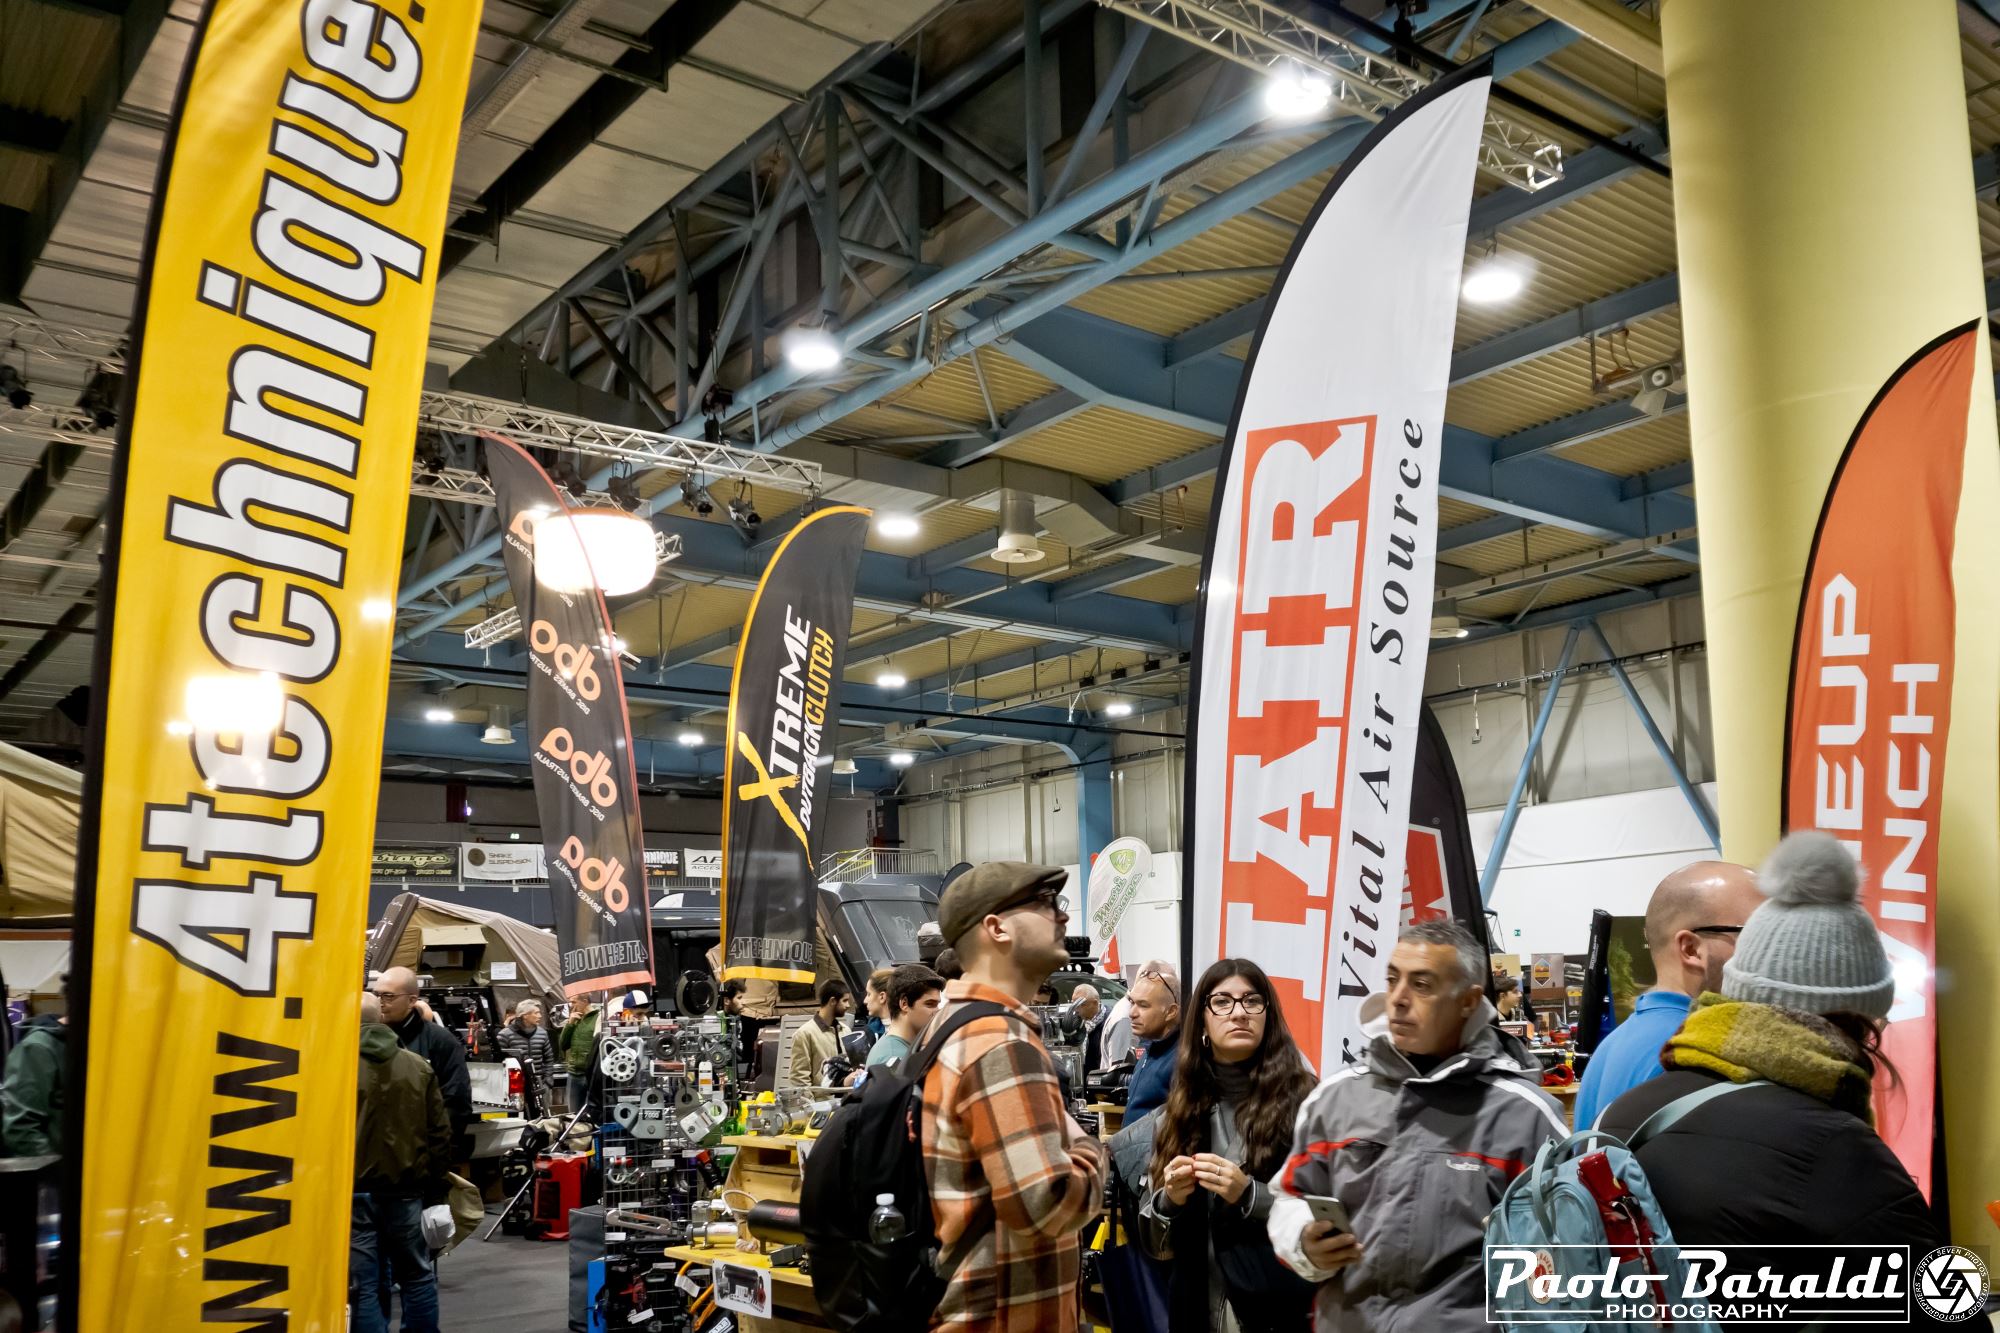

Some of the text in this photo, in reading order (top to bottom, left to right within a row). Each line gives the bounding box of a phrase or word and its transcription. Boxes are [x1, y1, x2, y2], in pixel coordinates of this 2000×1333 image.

[737, 603, 815, 877] XTREME
[1225, 422, 1368, 1003] IAIR
[1338, 418, 1424, 1000] Vital Air Source
[1816, 572, 1871, 862] EUP
